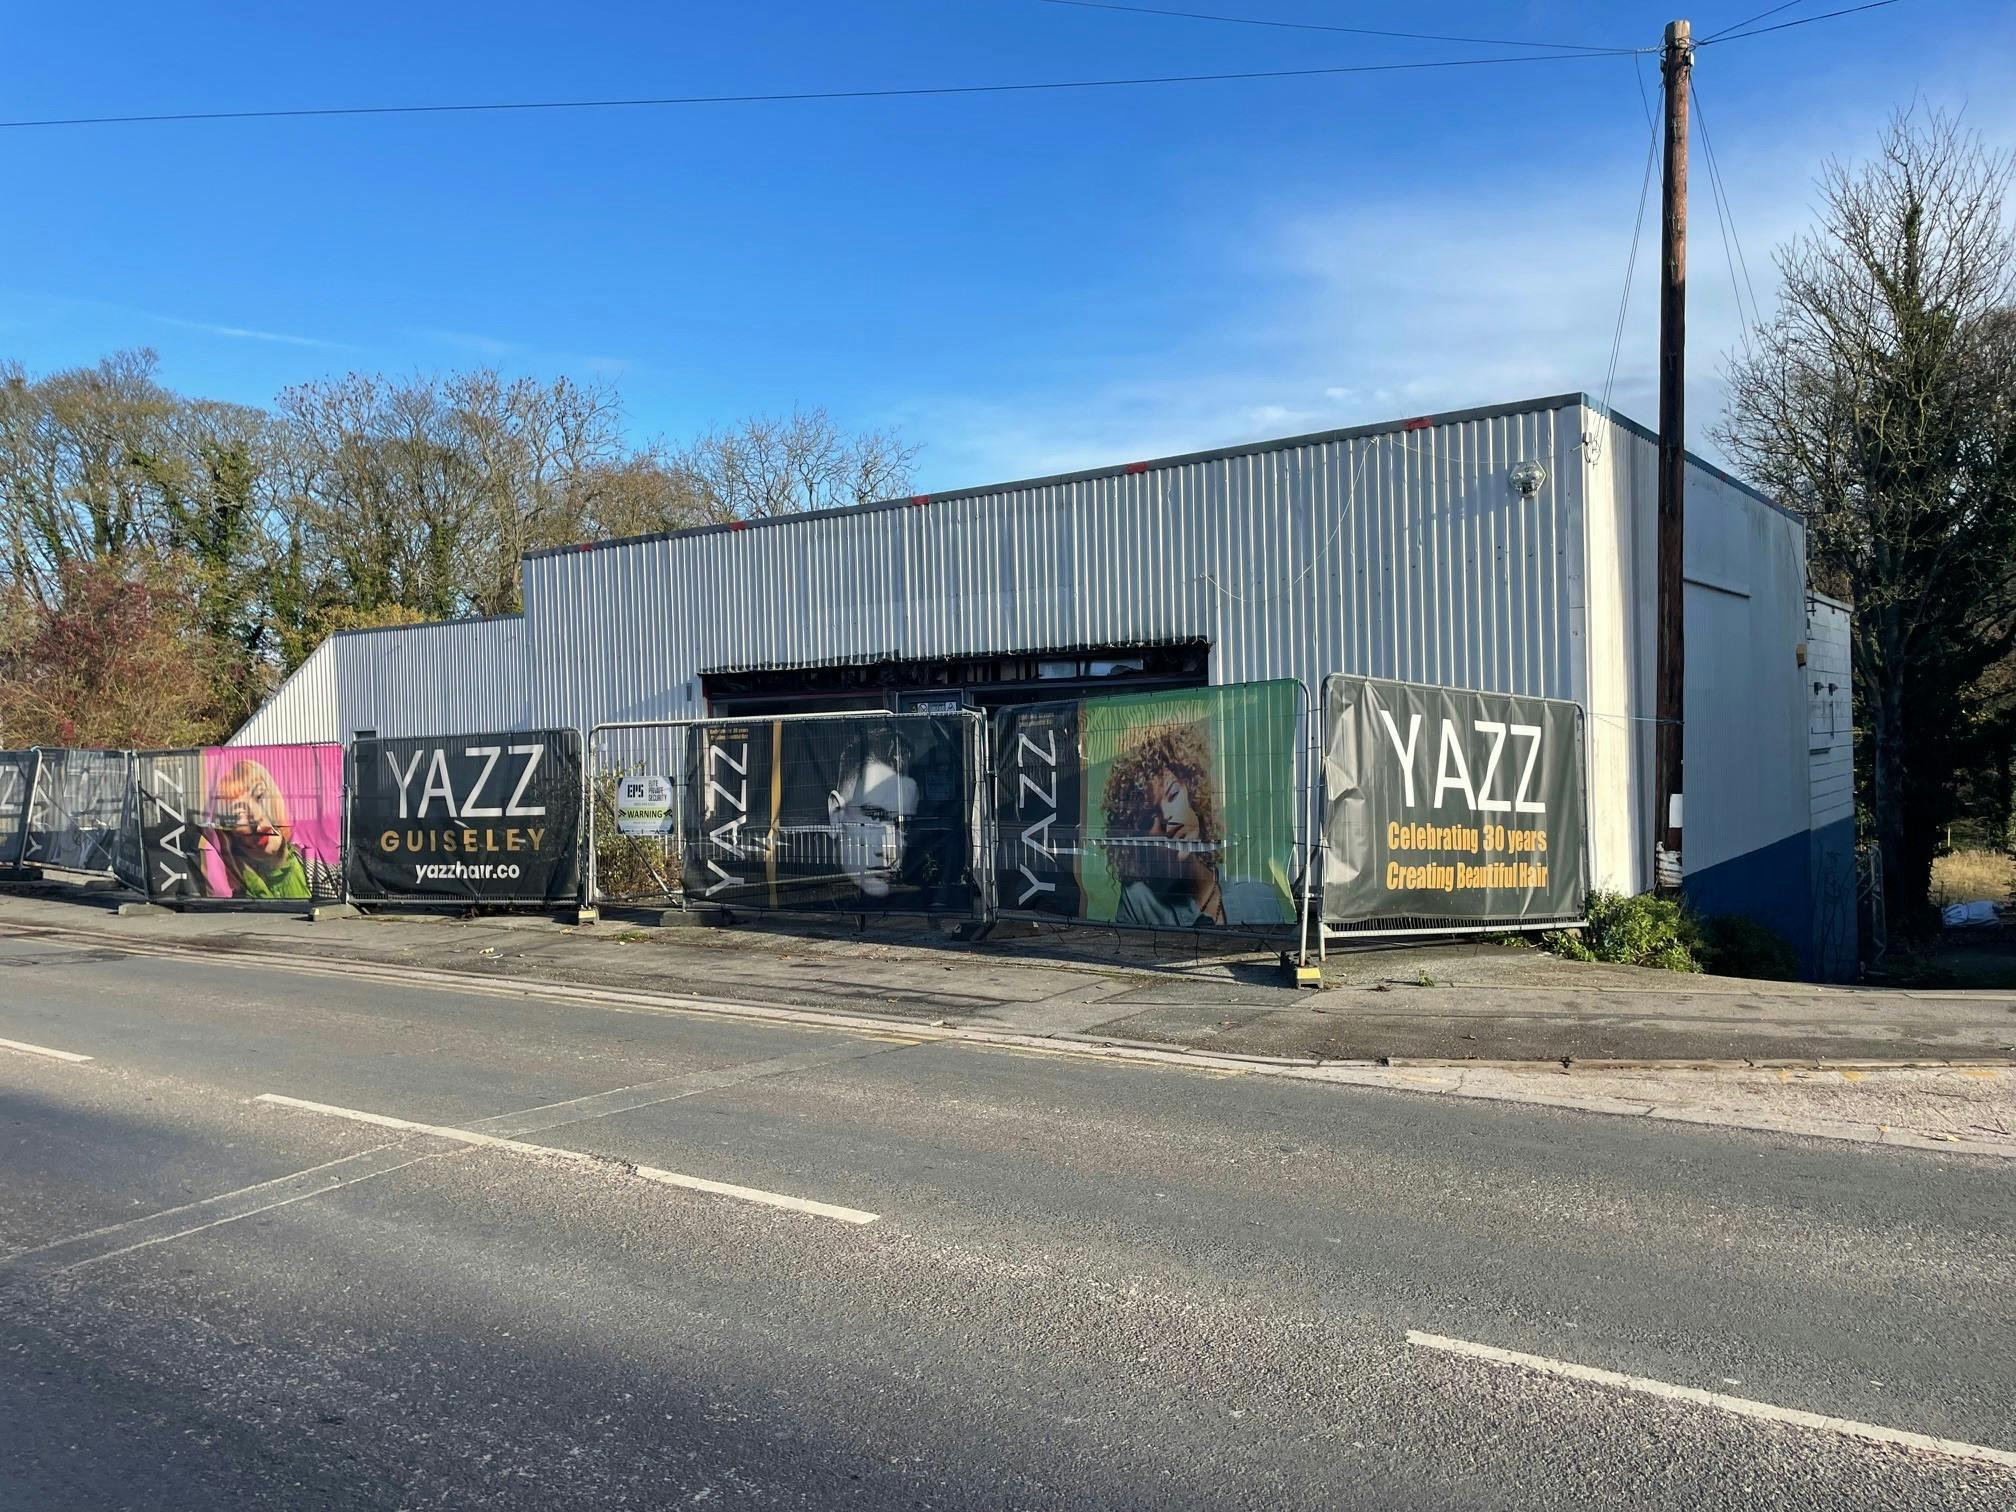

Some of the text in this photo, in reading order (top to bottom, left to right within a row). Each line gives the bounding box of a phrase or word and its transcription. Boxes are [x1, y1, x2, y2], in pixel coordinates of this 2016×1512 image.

[1380, 710, 1546, 813] YAZZ
[385, 744, 546, 819] YAZZ
[627, 784, 644, 798] EPS
[154, 767, 188, 892] YAZZ
[627, 810, 663, 819] WARNING
[706, 742, 748, 897] YAZZ
[1017, 729, 1057, 905] YAZZ
[380, 828, 546, 852] GUISELEY
[1387, 821, 1548, 855] Celebrating 30 years
[415, 861, 520, 884] yazzhair.co
[1386, 861, 1548, 892] Creating Beautiful Hair
